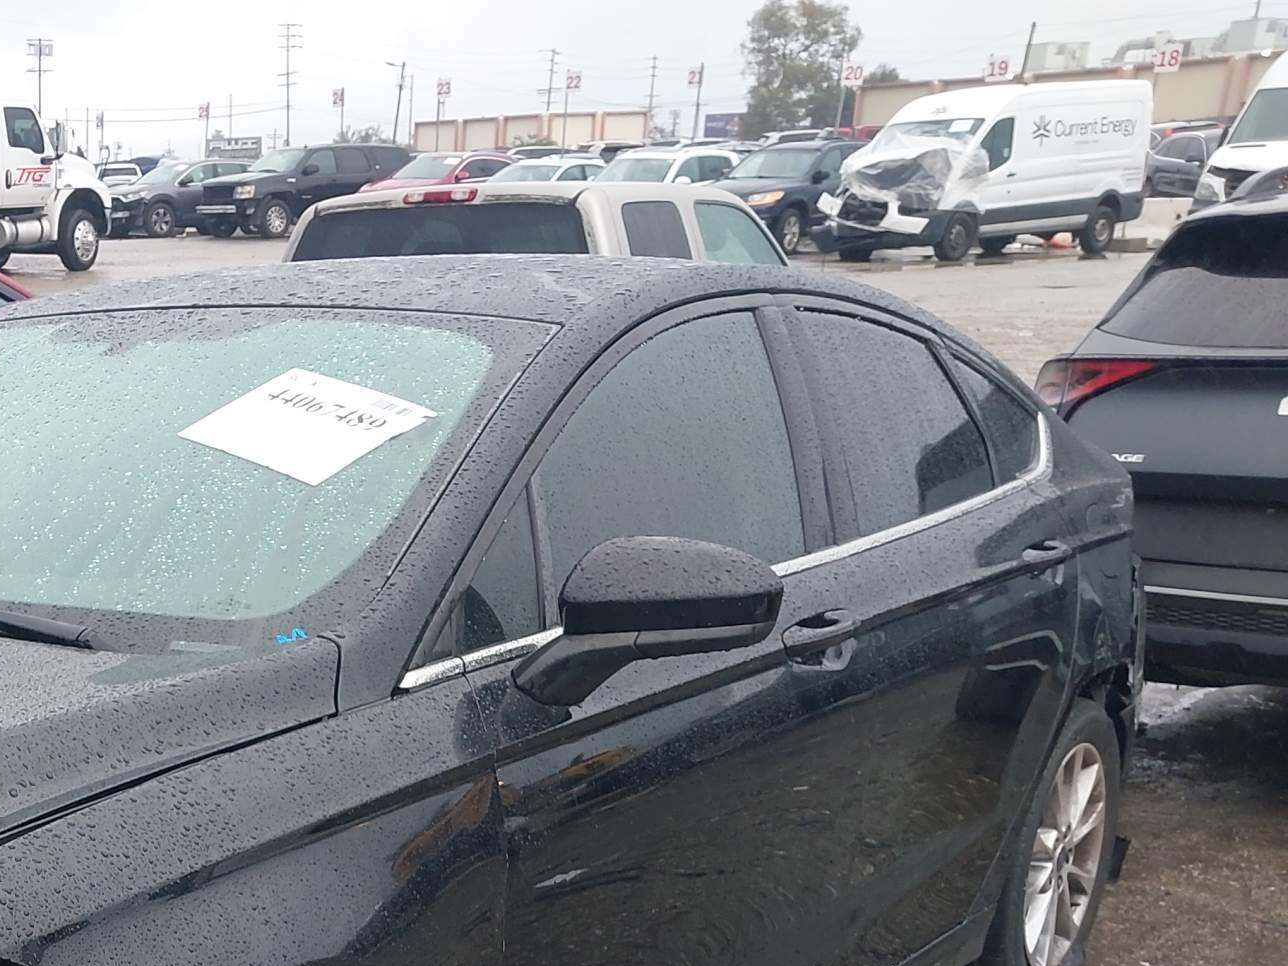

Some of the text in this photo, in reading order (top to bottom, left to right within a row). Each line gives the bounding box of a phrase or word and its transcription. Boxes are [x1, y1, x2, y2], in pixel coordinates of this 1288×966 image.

[1155, 49, 1181, 68] 18
[844, 66, 863, 81] 20
[987, 60, 1009, 77] 19
[437, 82, 451, 95] 23
[566, 75, 582, 89] 22
[1054, 117, 1137, 138] Current Energy
[16, 166, 51, 183] TTG
